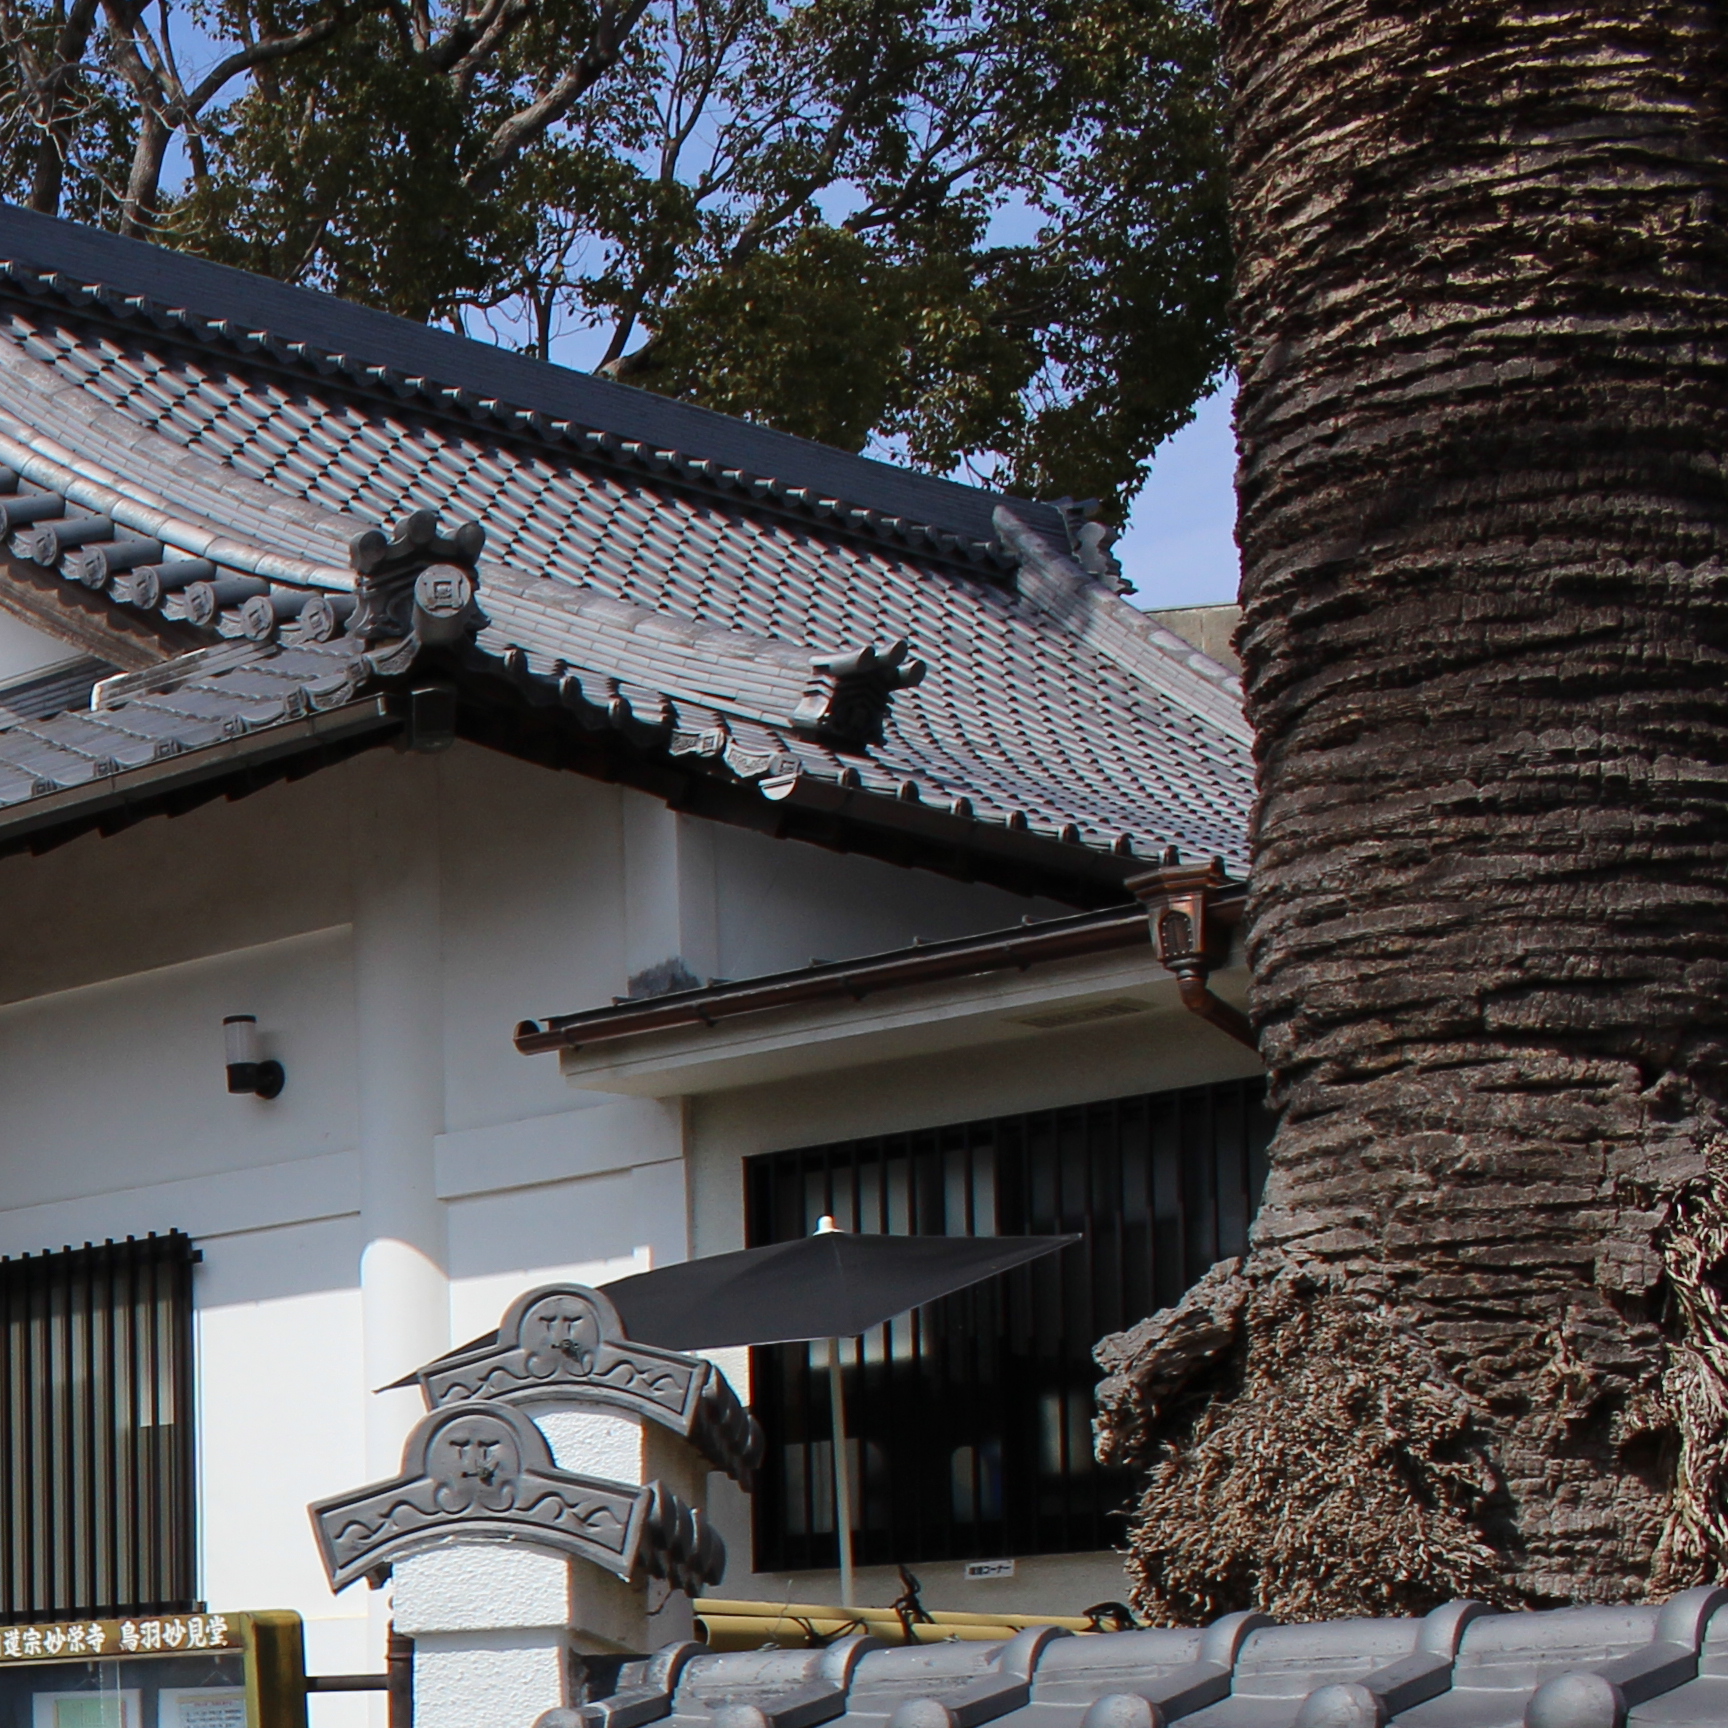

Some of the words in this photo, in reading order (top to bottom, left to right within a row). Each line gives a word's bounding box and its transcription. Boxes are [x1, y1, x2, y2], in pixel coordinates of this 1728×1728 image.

[119, 1615, 228, 1651] 鳥羽妙見堂
